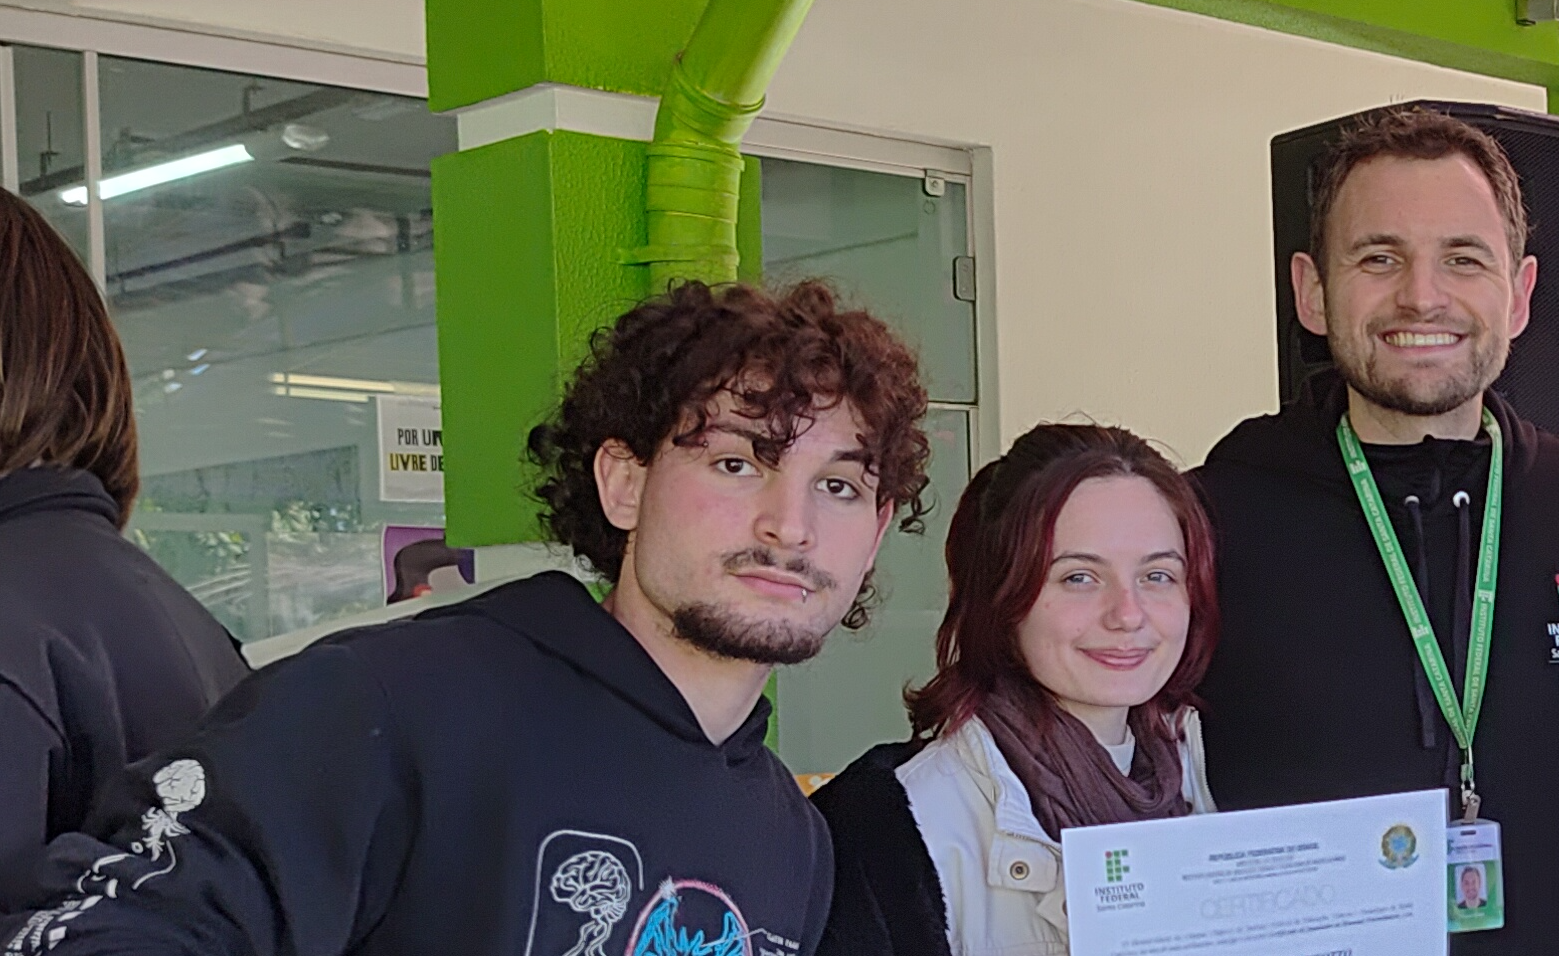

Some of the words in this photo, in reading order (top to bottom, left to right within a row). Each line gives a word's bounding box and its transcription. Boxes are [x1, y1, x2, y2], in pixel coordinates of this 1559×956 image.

[397, 428, 418, 446] POR
[390, 453, 427, 471] LIVRE
[431, 455, 444, 471] DE
[1374, 515, 1389, 542] SANTA
[1387, 551, 1406, 585] FEDERAL
[1400, 583, 1421, 624] INSTITUTO
[1474, 603, 1491, 642] INSTITUTO
[1470, 642, 1485, 674] FEDERAL
[1095, 882, 1144, 896] INSTITUTO
[1100, 893, 1140, 903] FEDERAL
